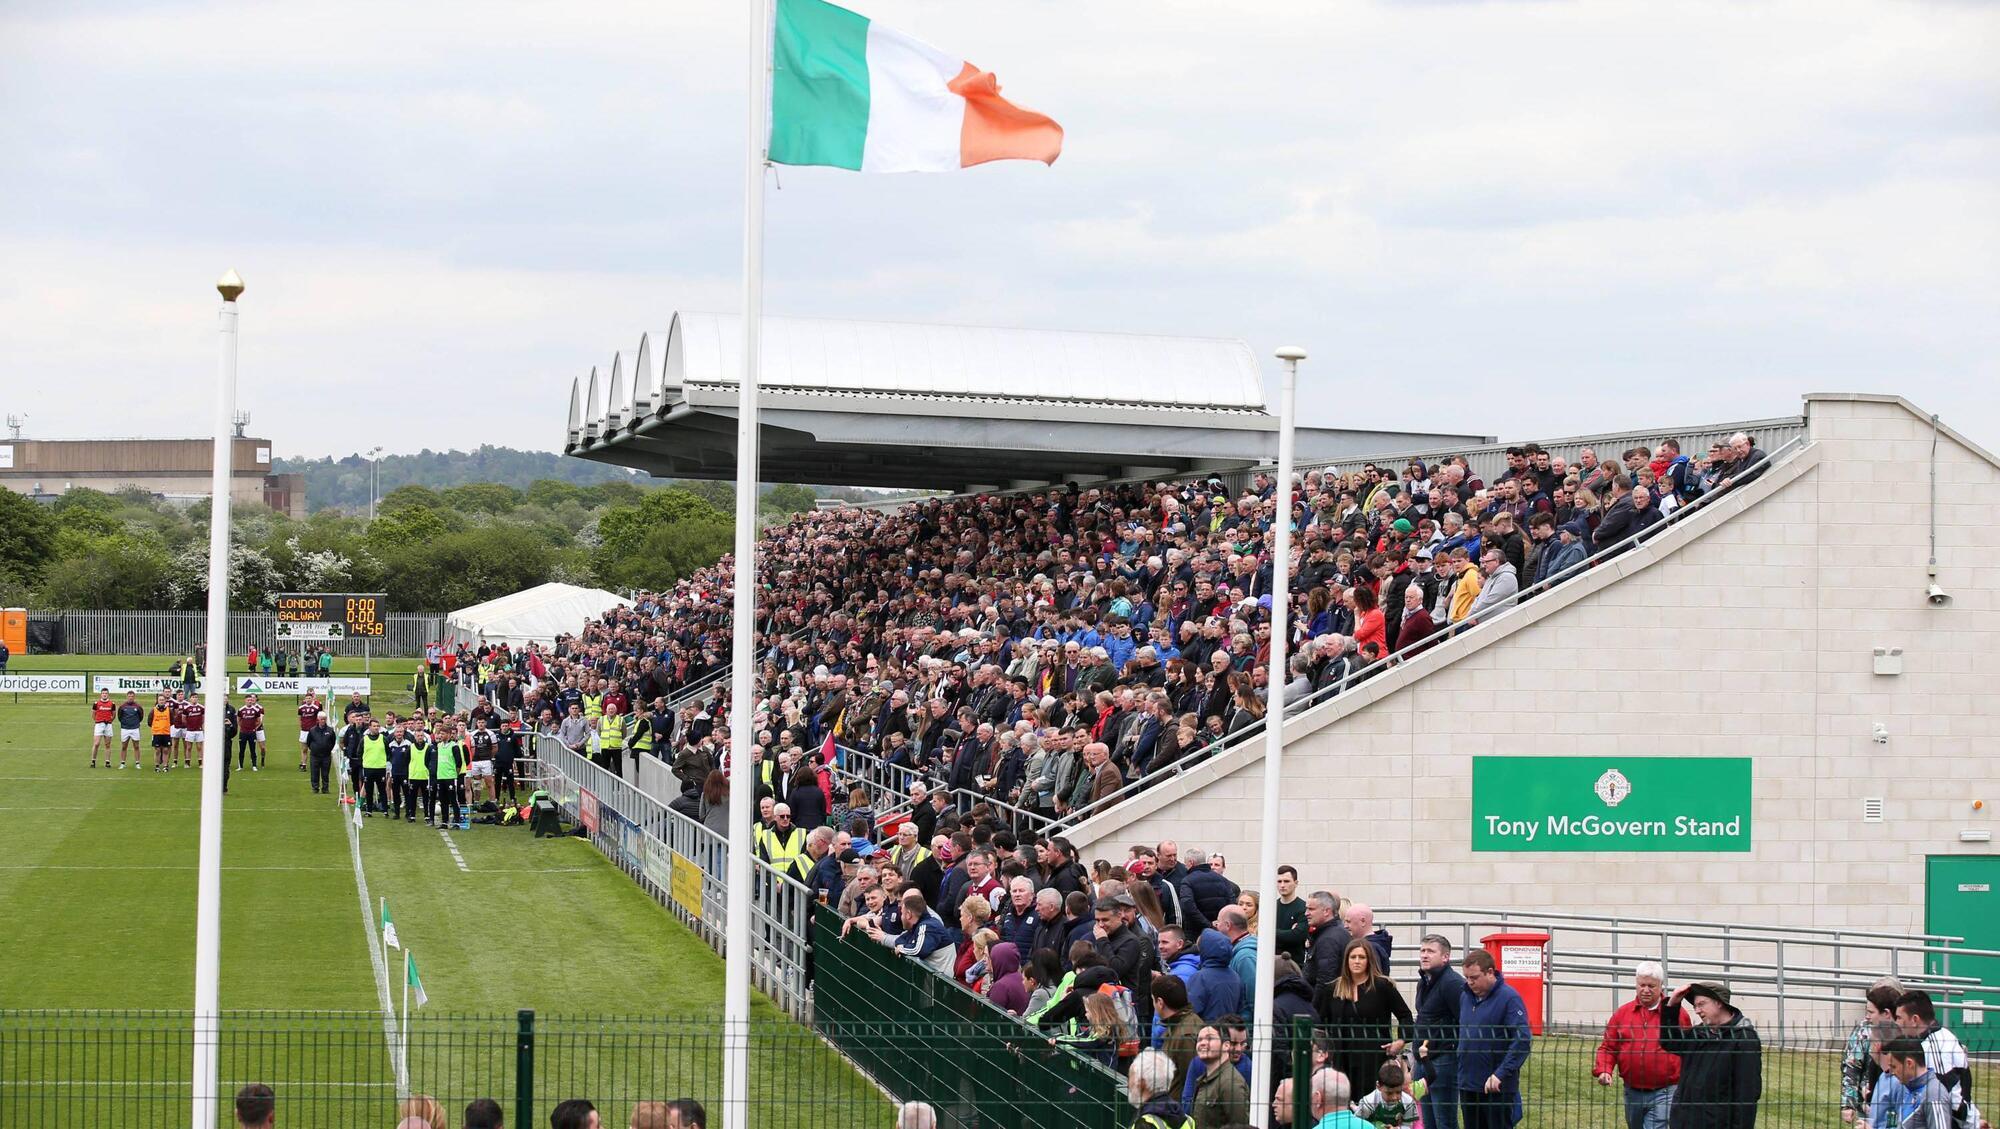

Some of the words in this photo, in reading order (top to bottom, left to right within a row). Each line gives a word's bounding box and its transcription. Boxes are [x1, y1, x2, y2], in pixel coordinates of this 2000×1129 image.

[279, 599, 322, 609] LONDON
[279, 611, 322, 621] GALWAY
[351, 623, 383, 635] 14:58
[119, 678, 150, 688] IRISH
[161, 679, 202, 689] WORD
[265, 681, 299, 690] DEANE
[1485, 815, 1539, 841] Tony
[1547, 815, 1666, 836] McGovern
[1674, 815, 1740, 836] Stand
